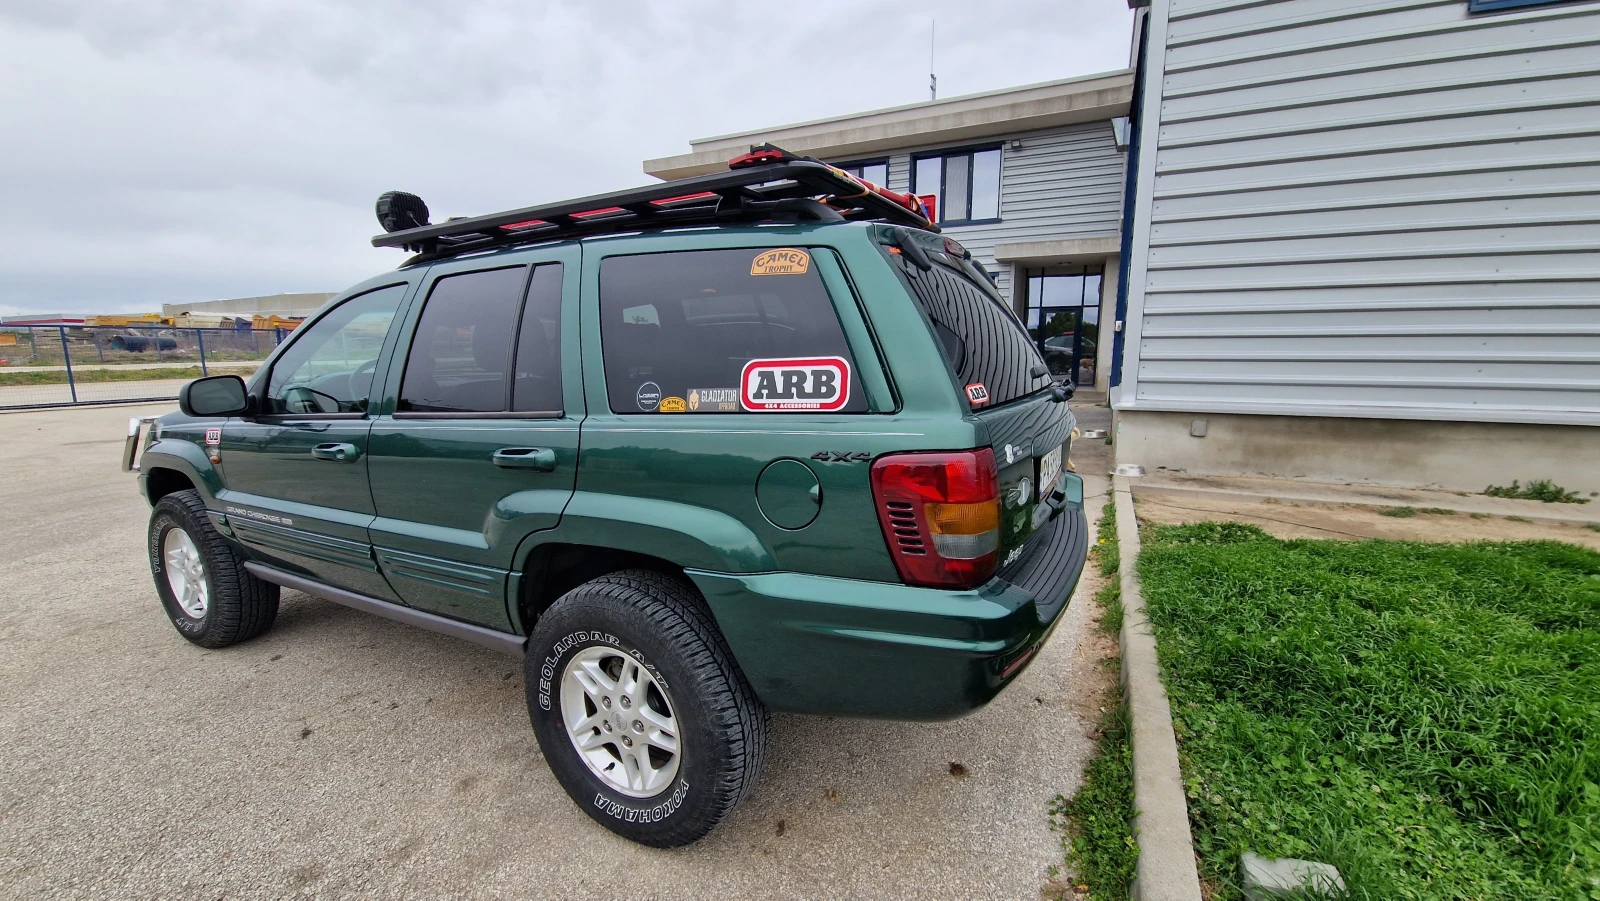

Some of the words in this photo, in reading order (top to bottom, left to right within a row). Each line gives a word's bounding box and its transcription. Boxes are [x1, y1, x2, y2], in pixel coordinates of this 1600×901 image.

[756, 252, 804, 267] CAMEL
[753, 369, 837, 399] ARB
[701, 389, 737, 403] GLADIATOR
[969, 386, 987, 400] ARB
[661, 400, 685, 408] CAMEL
[226, 506, 247, 516] GRAND
[247, 510, 280, 522] CHEROKEE
[539, 630, 620, 711] GEOLANDAR
[629, 648, 670, 689] A/T
[594, 778, 690, 823] YOKOHAMA
